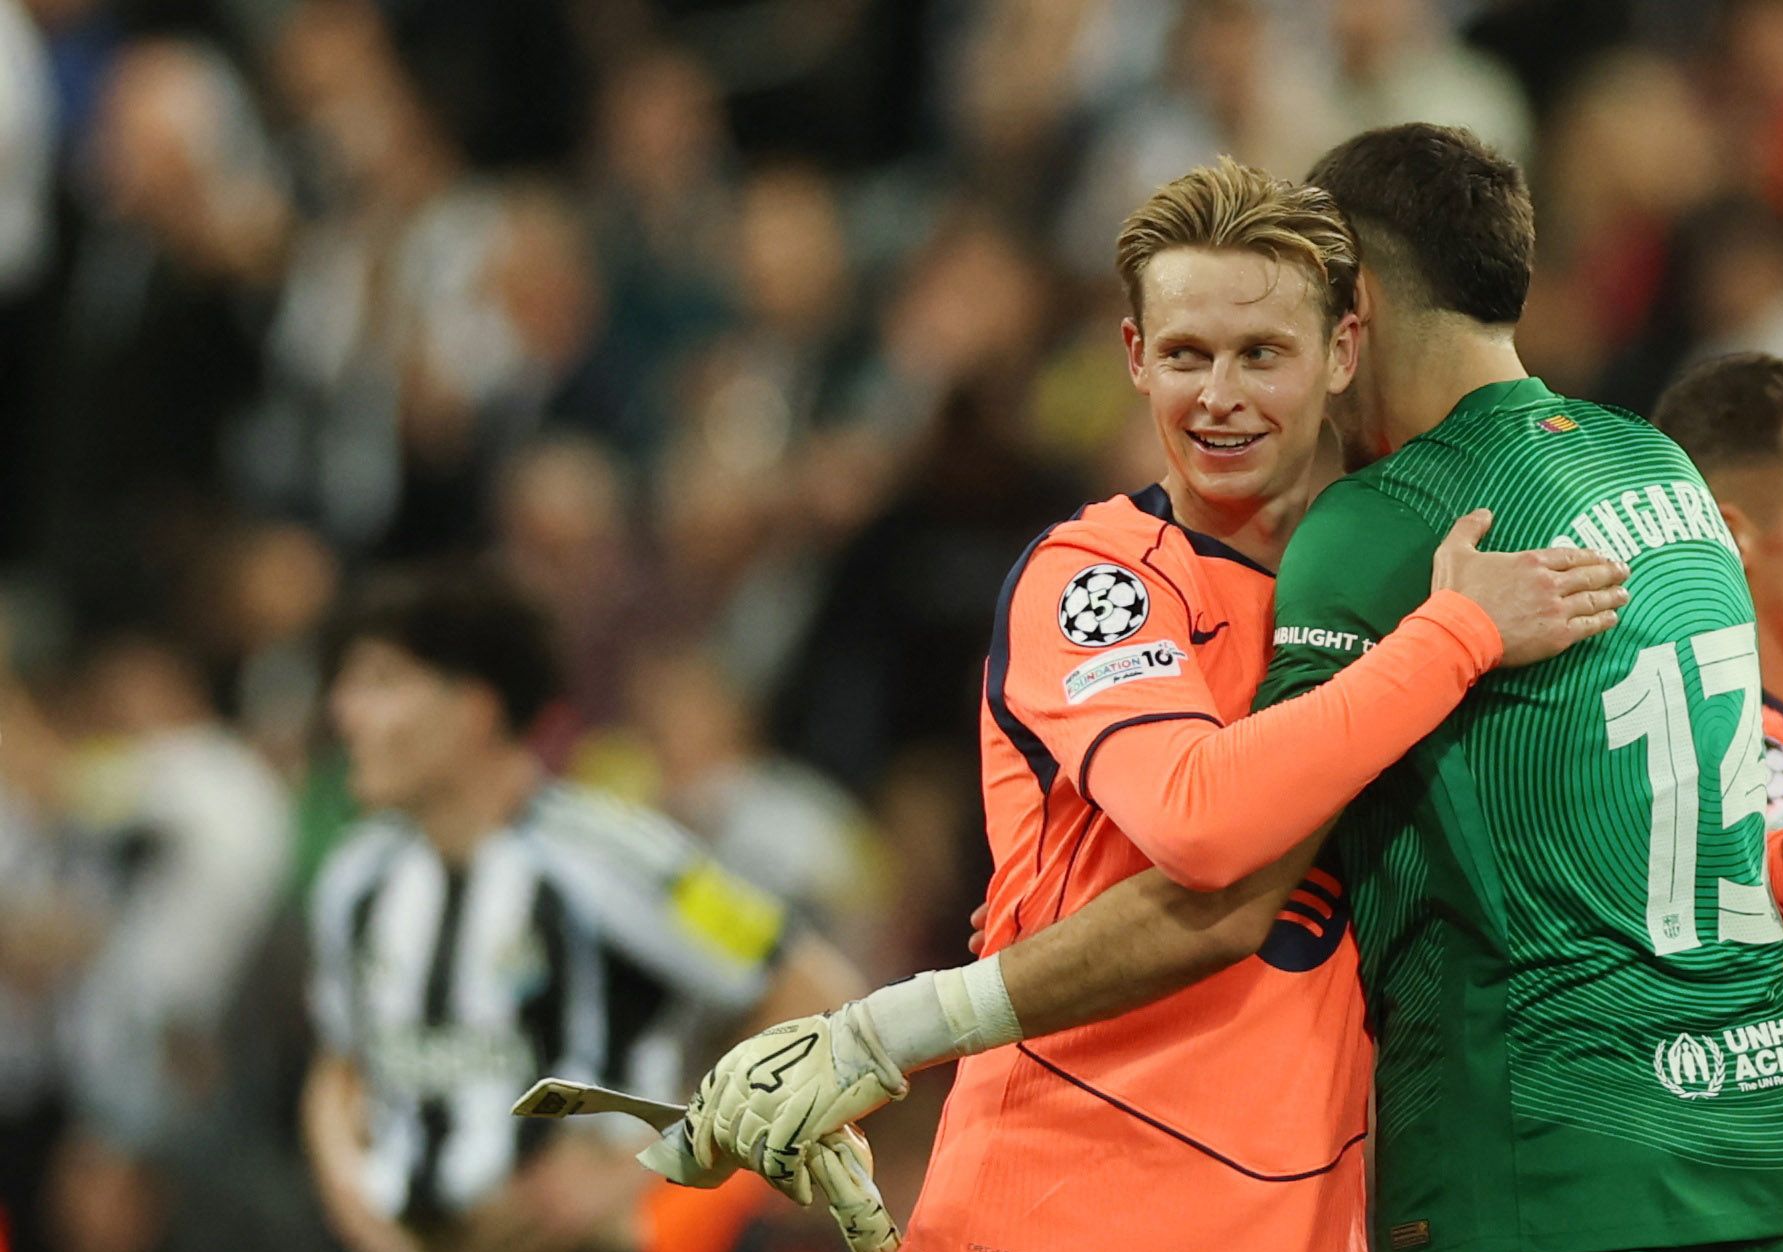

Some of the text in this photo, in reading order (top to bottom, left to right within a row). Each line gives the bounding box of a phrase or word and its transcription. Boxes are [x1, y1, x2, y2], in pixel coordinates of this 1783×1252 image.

[1089, 588, 1114, 621] 5
[1142, 649, 1173, 667] 10
[1738, 1081, 1757, 1093] The
[1757, 1076, 1774, 1089] UN
